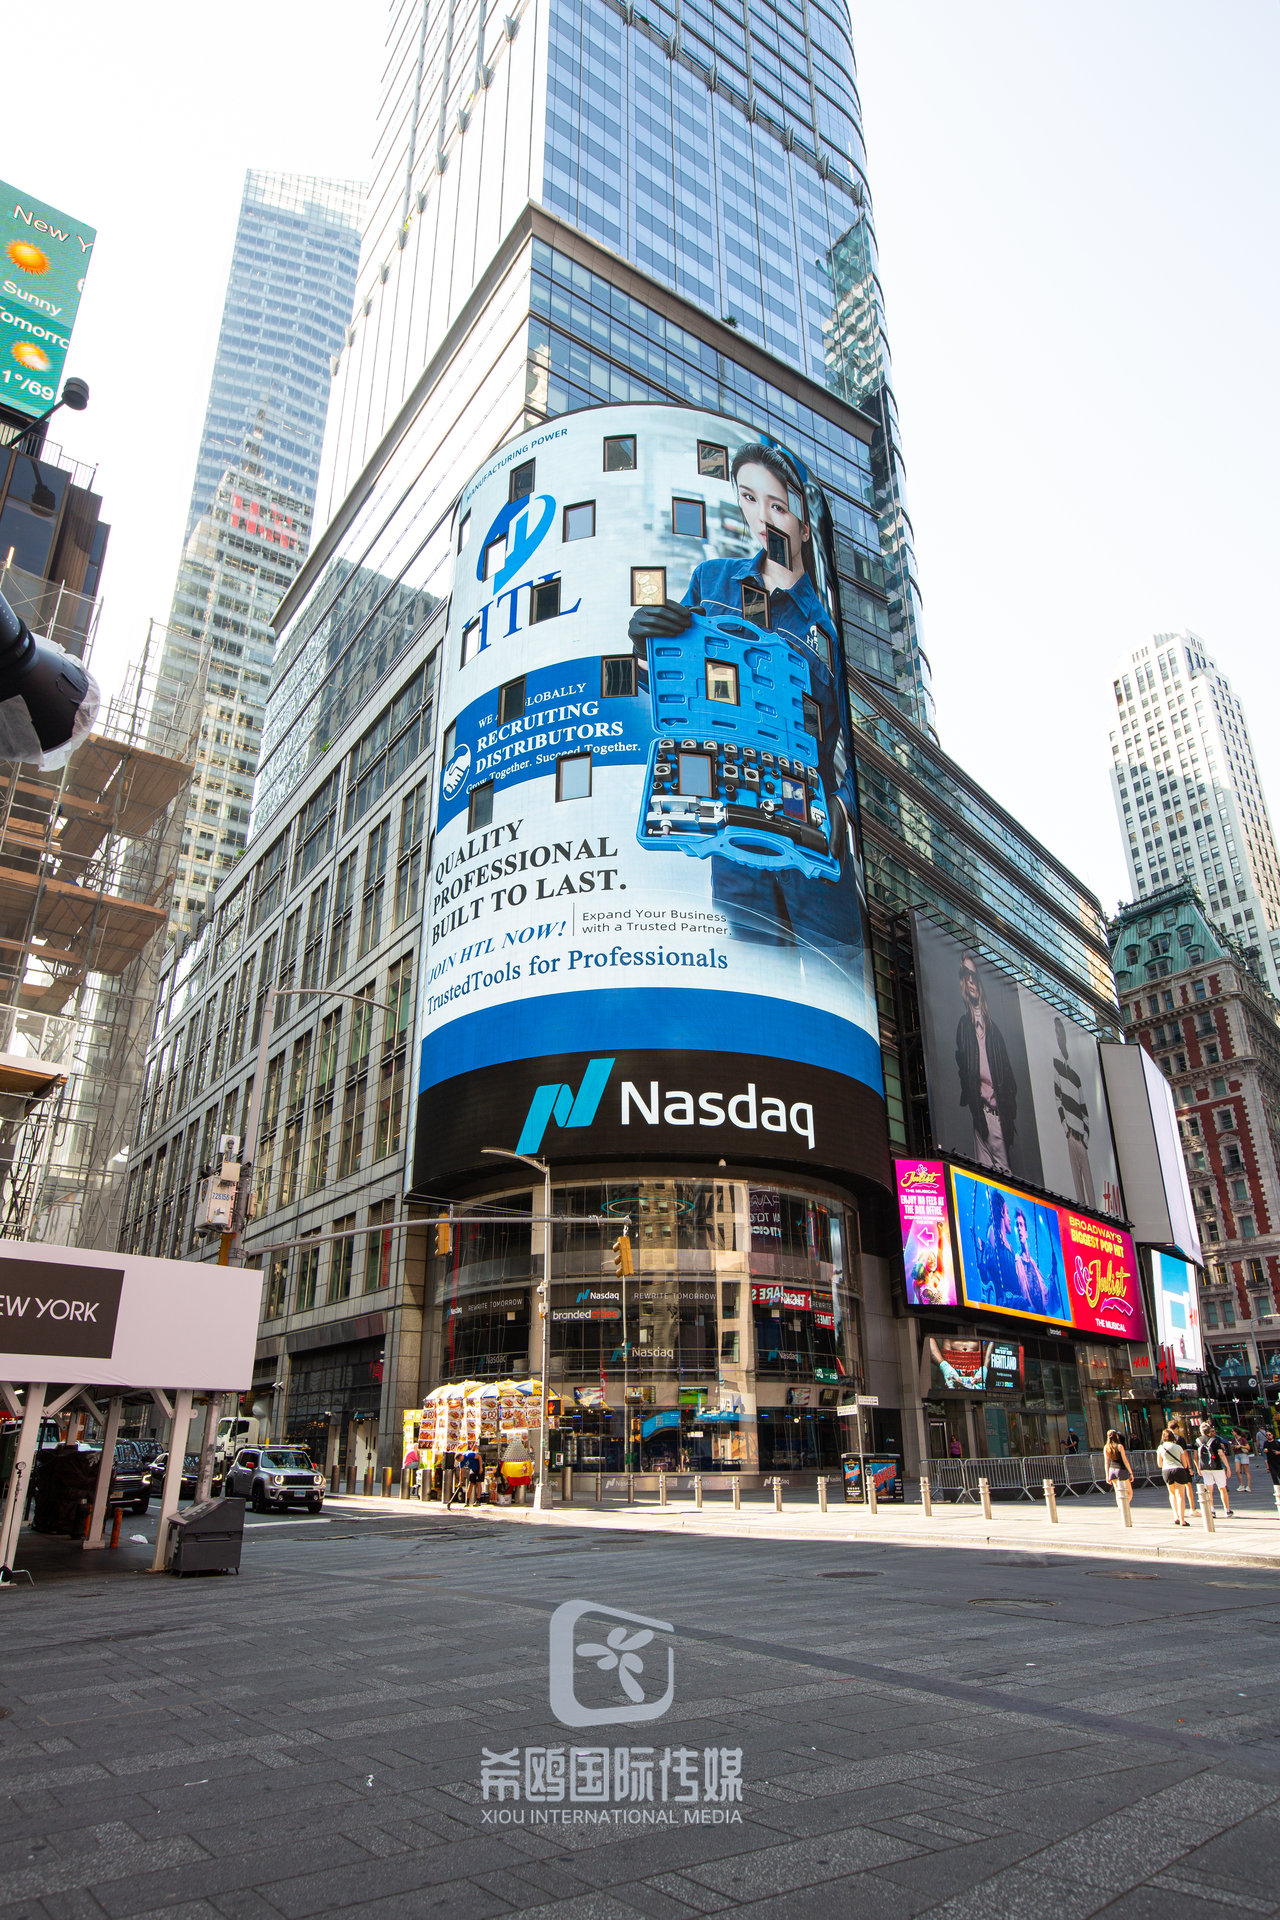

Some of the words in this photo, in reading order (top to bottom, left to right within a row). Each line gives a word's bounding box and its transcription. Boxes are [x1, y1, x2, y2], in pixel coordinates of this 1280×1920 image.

[13, 204, 70, 243] New
[2, 279, 62, 317] Sunny
[0, 306, 70, 350] omorro
[466, 445, 529, 503] MANUFACTURING
[531, 428, 568, 449] POWER
[478, 714, 493, 729] WE
[525, 682, 587, 707] LOBALLY
[477, 700, 599, 753] RECRUITING
[475, 720, 624, 775] DISTRIBUTORS
[489, 759, 533, 782] Together.
[584, 741, 642, 756] Together.
[435, 819, 525, 886] QUALITY
[432, 836, 618, 917] PROFESSIONAL
[431, 896, 484, 947] BUILT
[491, 883, 528, 913] TO
[535, 868, 627, 901] LAST.
[582, 909, 631, 923] Expand
[636, 909, 667, 919] Your
[670, 909, 727, 923] Business
[582, 922, 610, 934] with
[614, 924, 623, 932] a
[627, 921, 677, 932] Trusted
[681, 923, 733, 936] Partner.
[427, 954, 458, 986] JOIN
[459, 937, 495, 965] HTL
[502, 920, 567, 950] NOW!
[427, 961, 521, 1016] TrustedTools
[528, 955, 561, 976] for
[568, 946, 728, 971] Professionals
[621, 1080, 816, 1150] Nasdaq
[904, 1205, 914, 1214] THE
[914, 1205, 926, 1215] BOX
[926, 1206, 942, 1216] OFFICE
[1068, 1215, 1123, 1244] BROADWAY'S
[1070, 1228, 1099, 1250] BIGGEST
[1099, 1238, 1113, 1254] POP
[1113, 1243, 1124, 1259] HIT
[590, 1291, 620, 1301] Nasdaq
[633, 1292, 670, 1300] REWRITE
[672, 1292, 717, 1300] TOMORROW
[1086, 1259, 1131, 1308] Juliet
[35, 1297, 100, 1323] YORK
[467, 1302, 488, 1312] REWRITE
[490, 1298, 523, 1308] TOMORROW
[552, 1308, 619, 1320] brandedcities
[1095, 1317, 1106, 1328] THE
[1105, 1320, 1127, 1332] MUSICAL
[631, 1346, 674, 1360] Nasdaq
